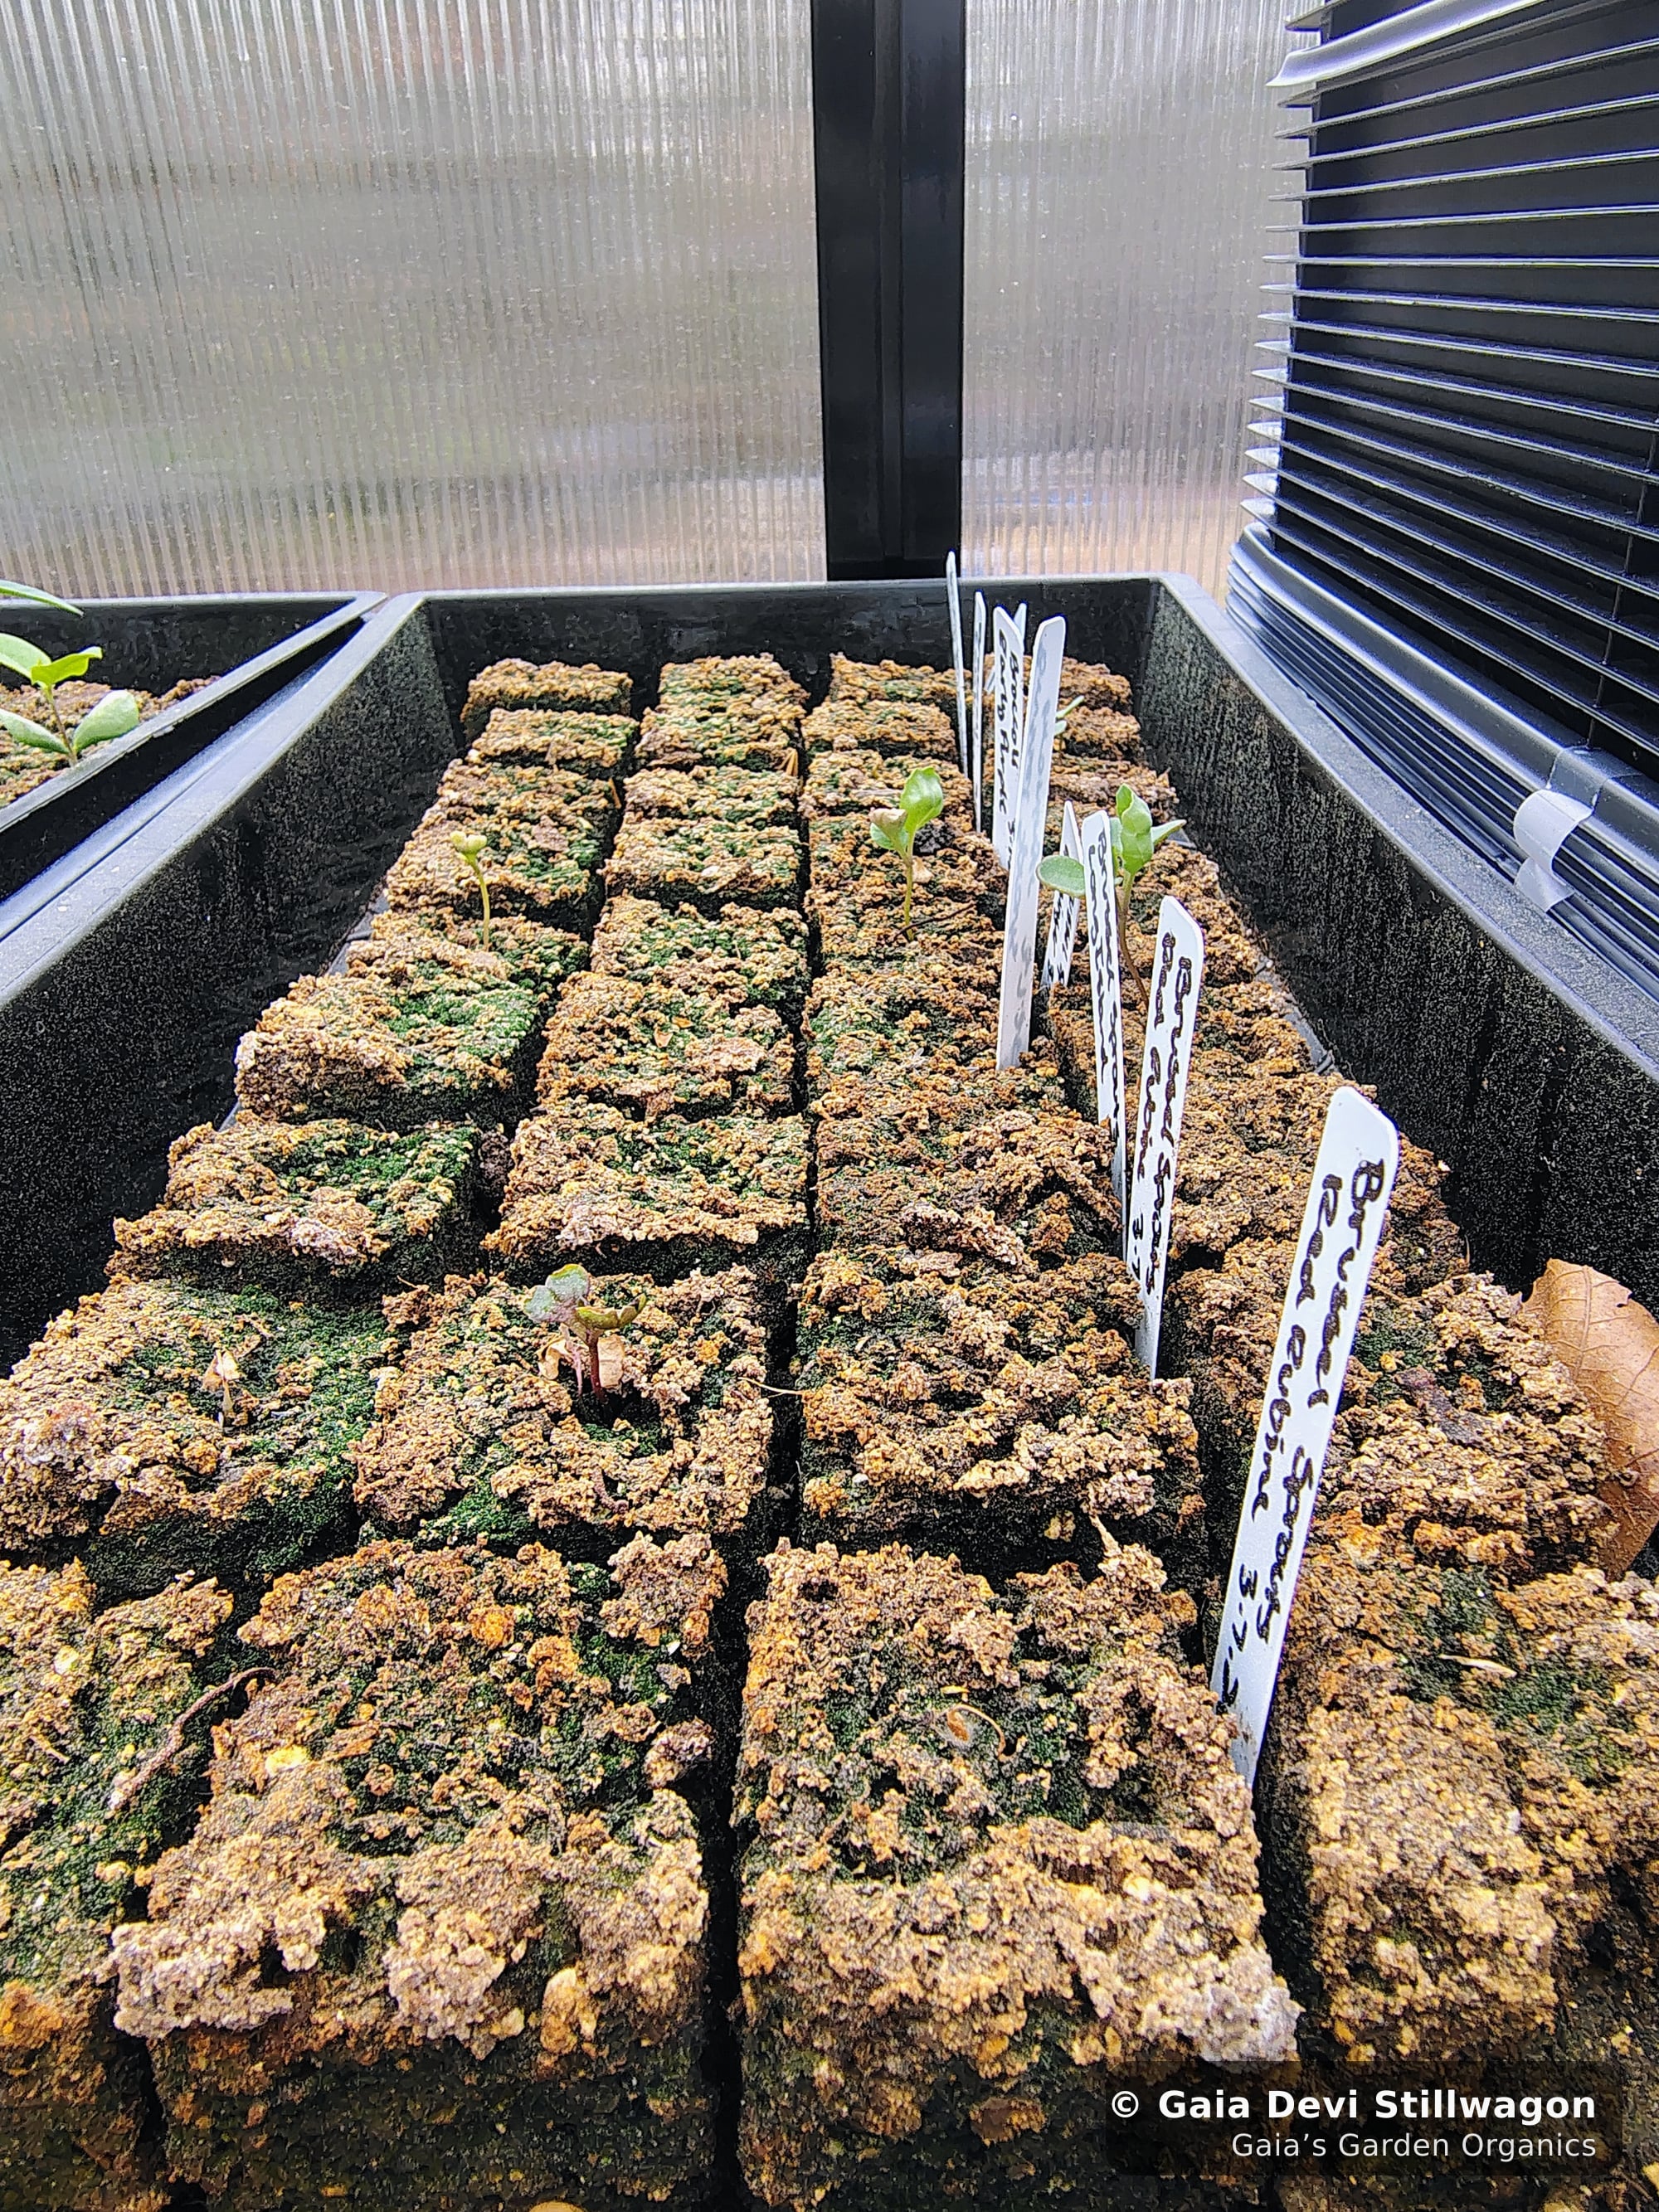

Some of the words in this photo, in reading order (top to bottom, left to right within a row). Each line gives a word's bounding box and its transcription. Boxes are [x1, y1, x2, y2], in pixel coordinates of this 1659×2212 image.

[1154, 931, 1176, 1031] Red
[1160, 955, 1193, 1148] Brussel
[1137, 1046, 1161, 1184] Rubine
[1295, 1173, 1343, 1310] Red
[1306, 1158, 1385, 1409] Brussel
[1251, 1324, 1306, 1524] Rubine
[1256, 1444, 1315, 1645] Sprouts
